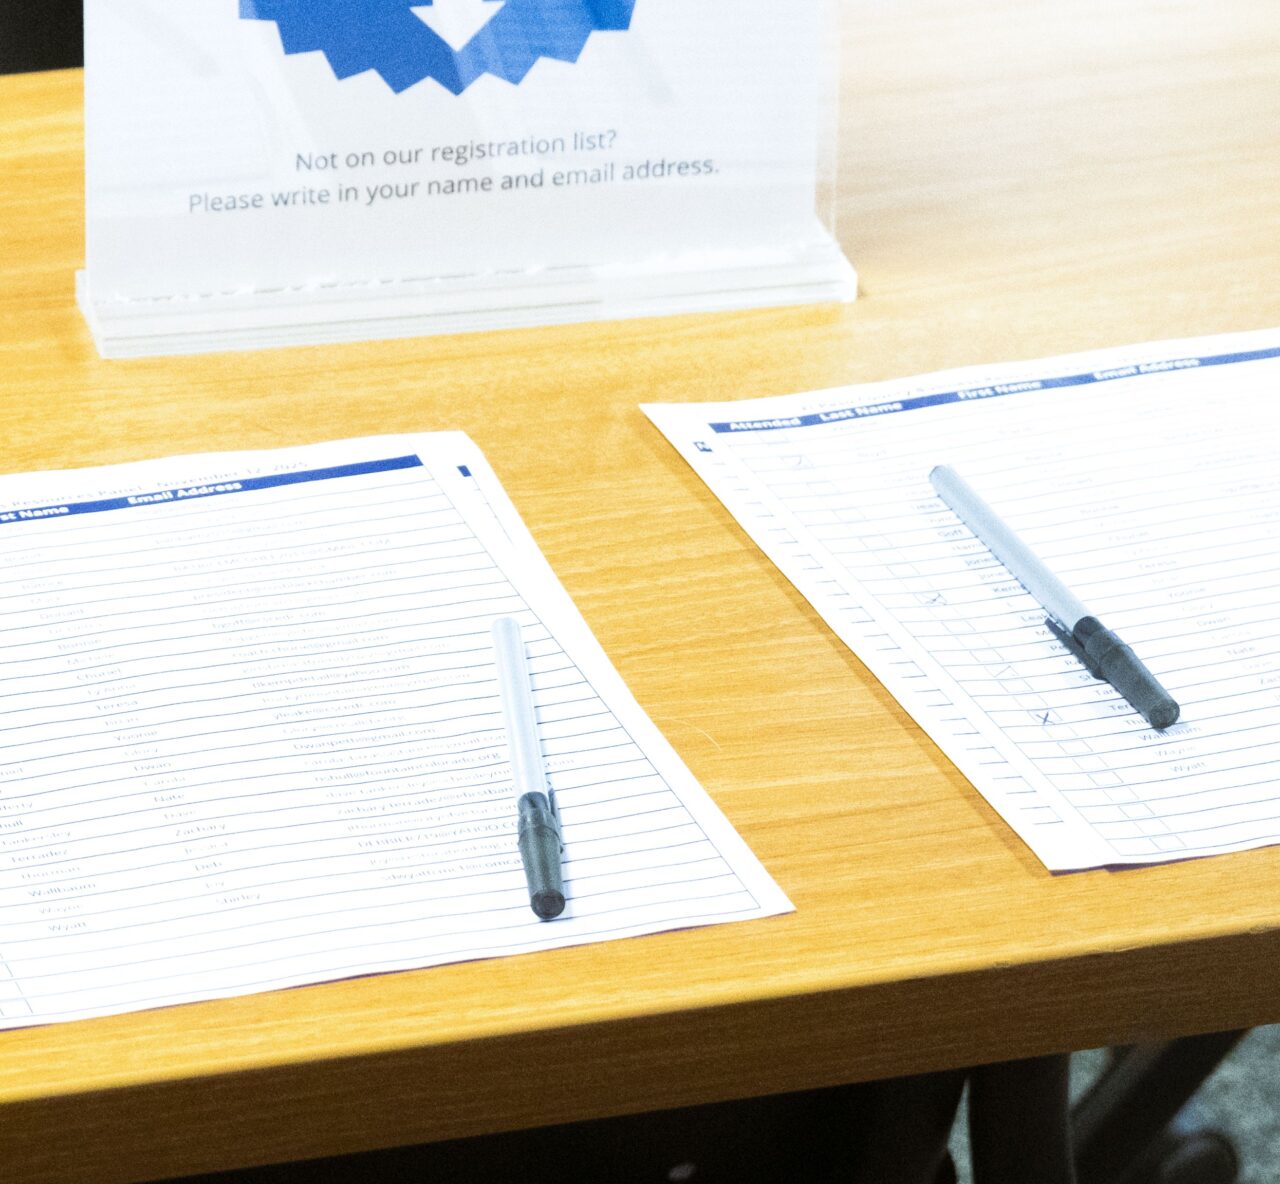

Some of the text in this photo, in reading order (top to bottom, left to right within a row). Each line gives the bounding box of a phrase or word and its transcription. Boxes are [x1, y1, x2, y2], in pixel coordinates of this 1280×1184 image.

[295, 128, 617, 171] Not on our registration list?
[189, 157, 719, 212] Please write in your name and email address.
[128, 481, 242, 506] Email Address
[21, 506, 70, 520] Name
